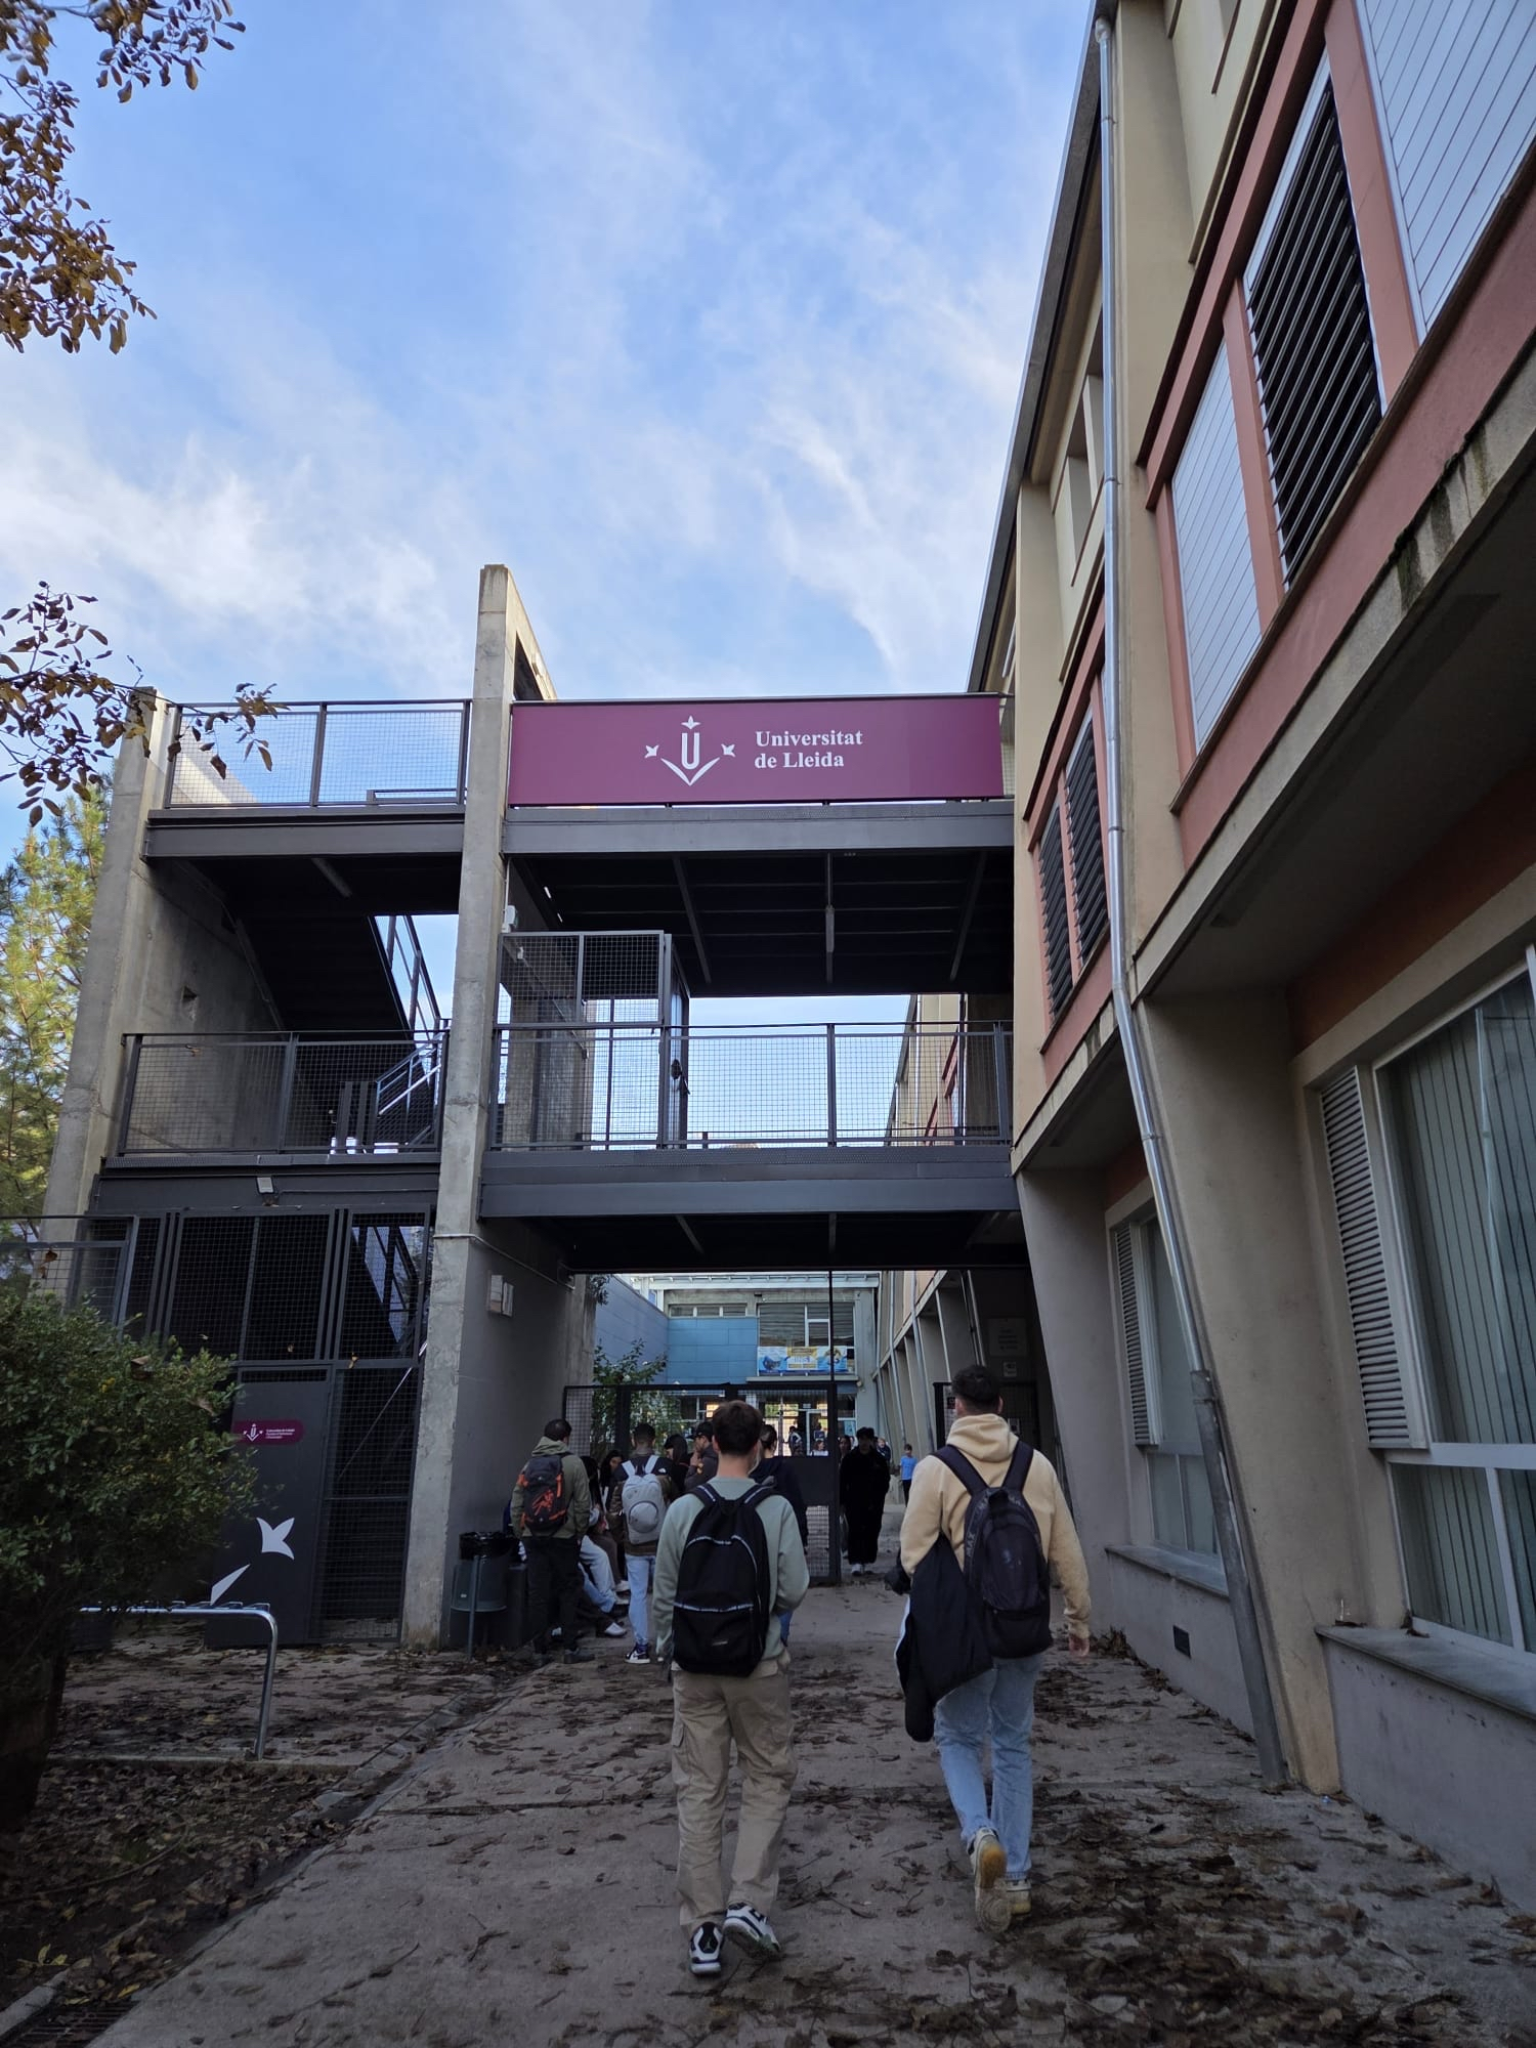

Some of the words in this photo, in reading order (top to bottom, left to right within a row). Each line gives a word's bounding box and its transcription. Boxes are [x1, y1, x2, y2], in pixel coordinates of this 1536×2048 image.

[755, 730, 863, 747] Universitat
[754, 753, 777, 768] de
[782, 751, 844, 768] Lleida
